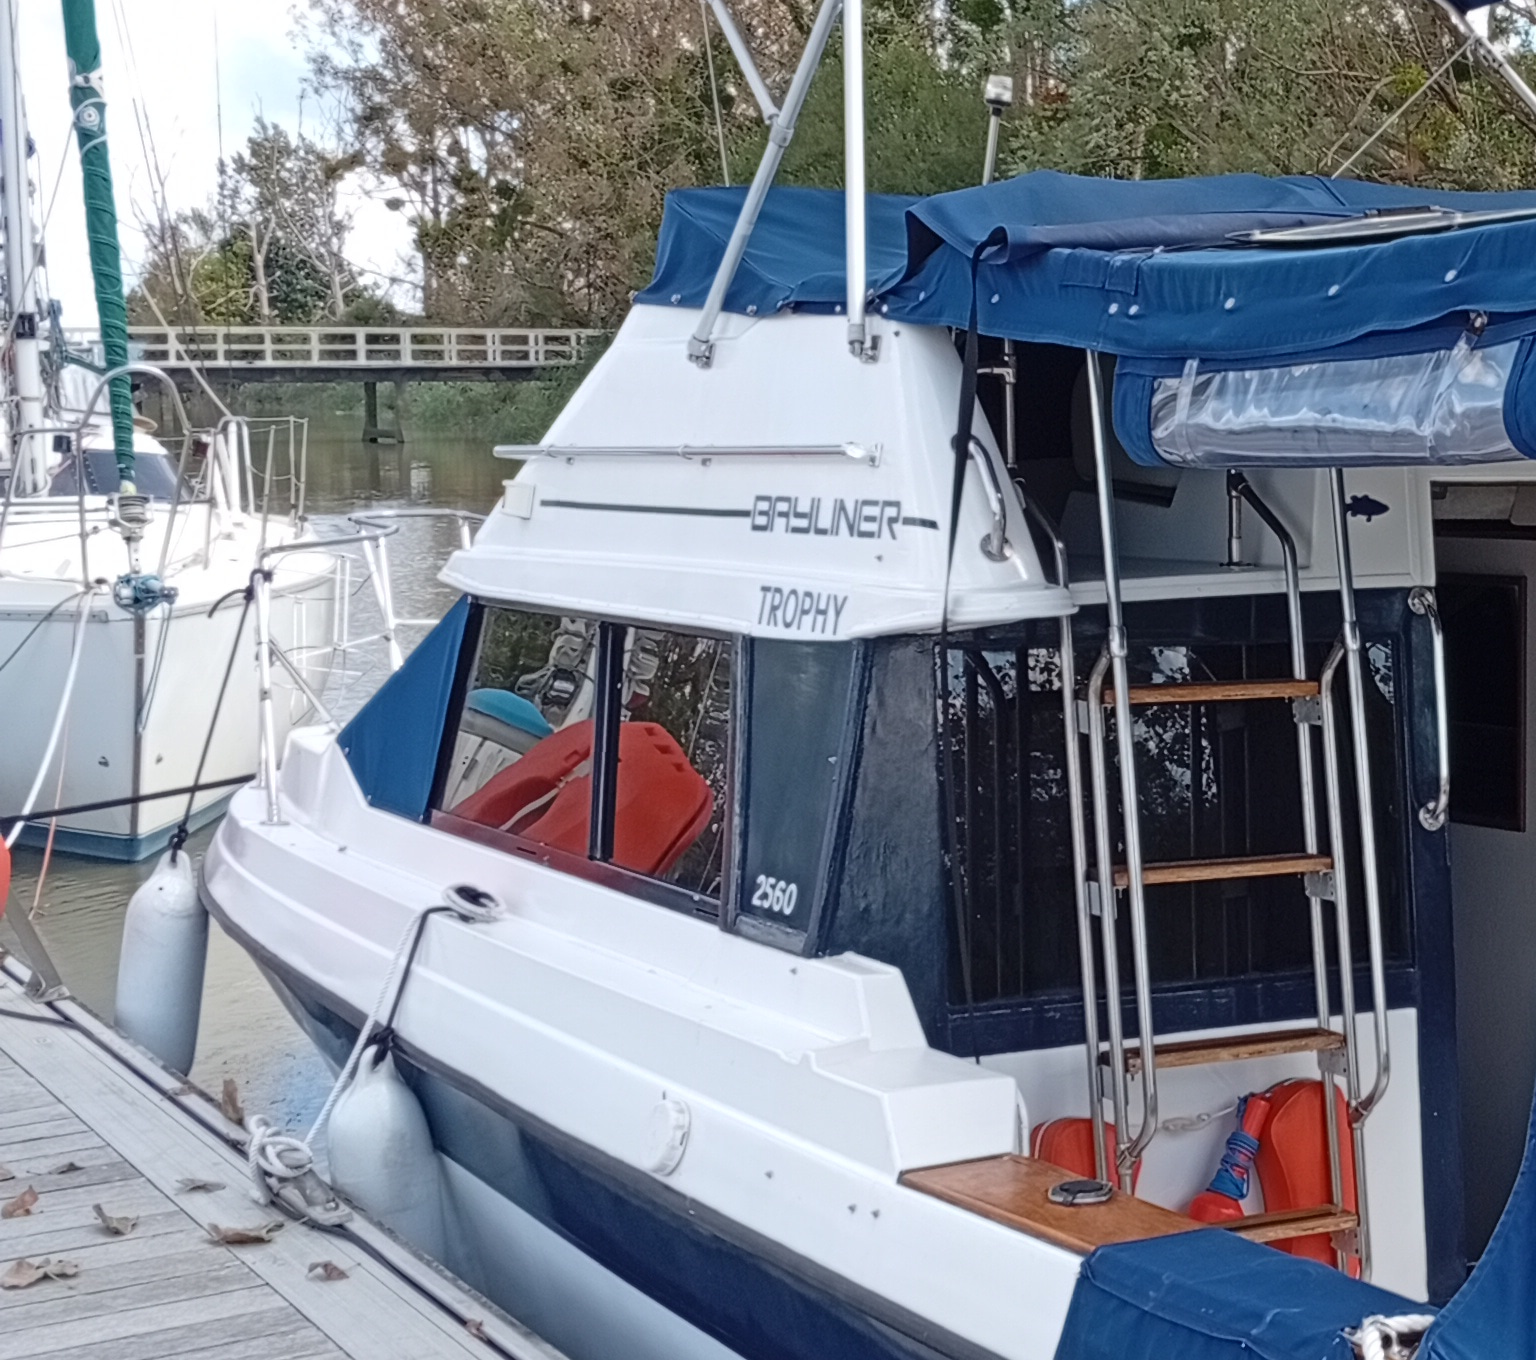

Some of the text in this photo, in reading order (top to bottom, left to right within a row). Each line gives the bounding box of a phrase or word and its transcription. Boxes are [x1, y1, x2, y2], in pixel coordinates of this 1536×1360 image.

[750, 495, 902, 541] BAYLINER
[757, 585, 849, 636] TROPHY
[750, 873, 798, 916] 2560
